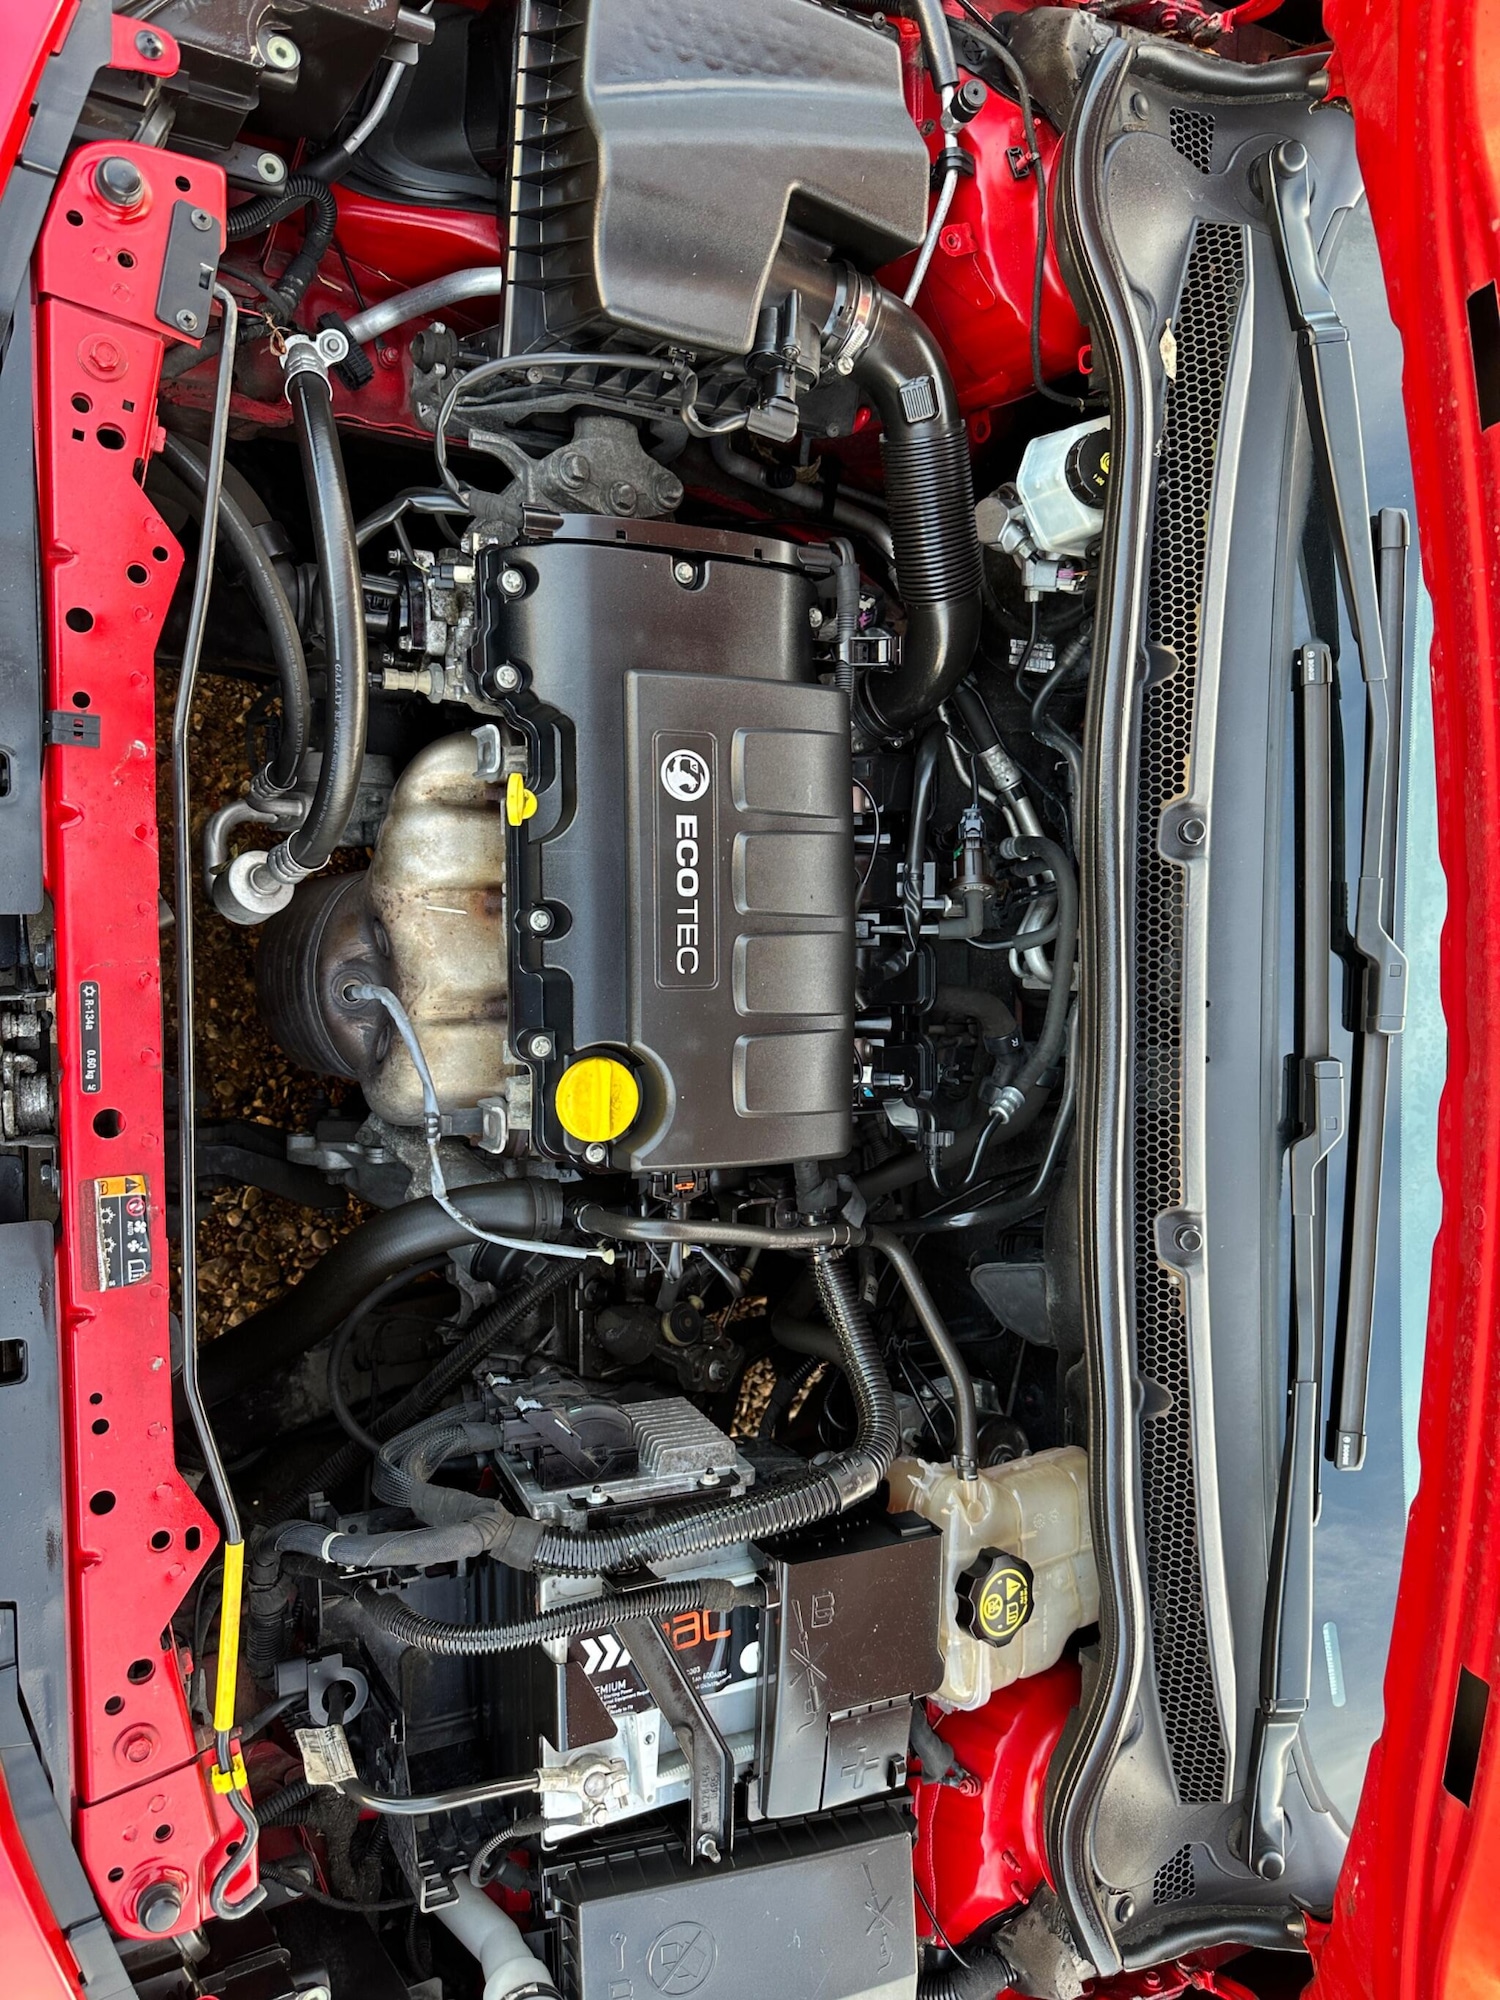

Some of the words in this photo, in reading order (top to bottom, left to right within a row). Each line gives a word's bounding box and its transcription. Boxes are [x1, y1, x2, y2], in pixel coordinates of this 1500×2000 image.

[334, 664, 342, 706] GALAXY
[676, 813, 699, 975] ECOTEC
[85, 999, 96, 1030] R-134a
[86, 1049, 96, 1068] 0.60
[85, 1070, 96, 1080] kg
